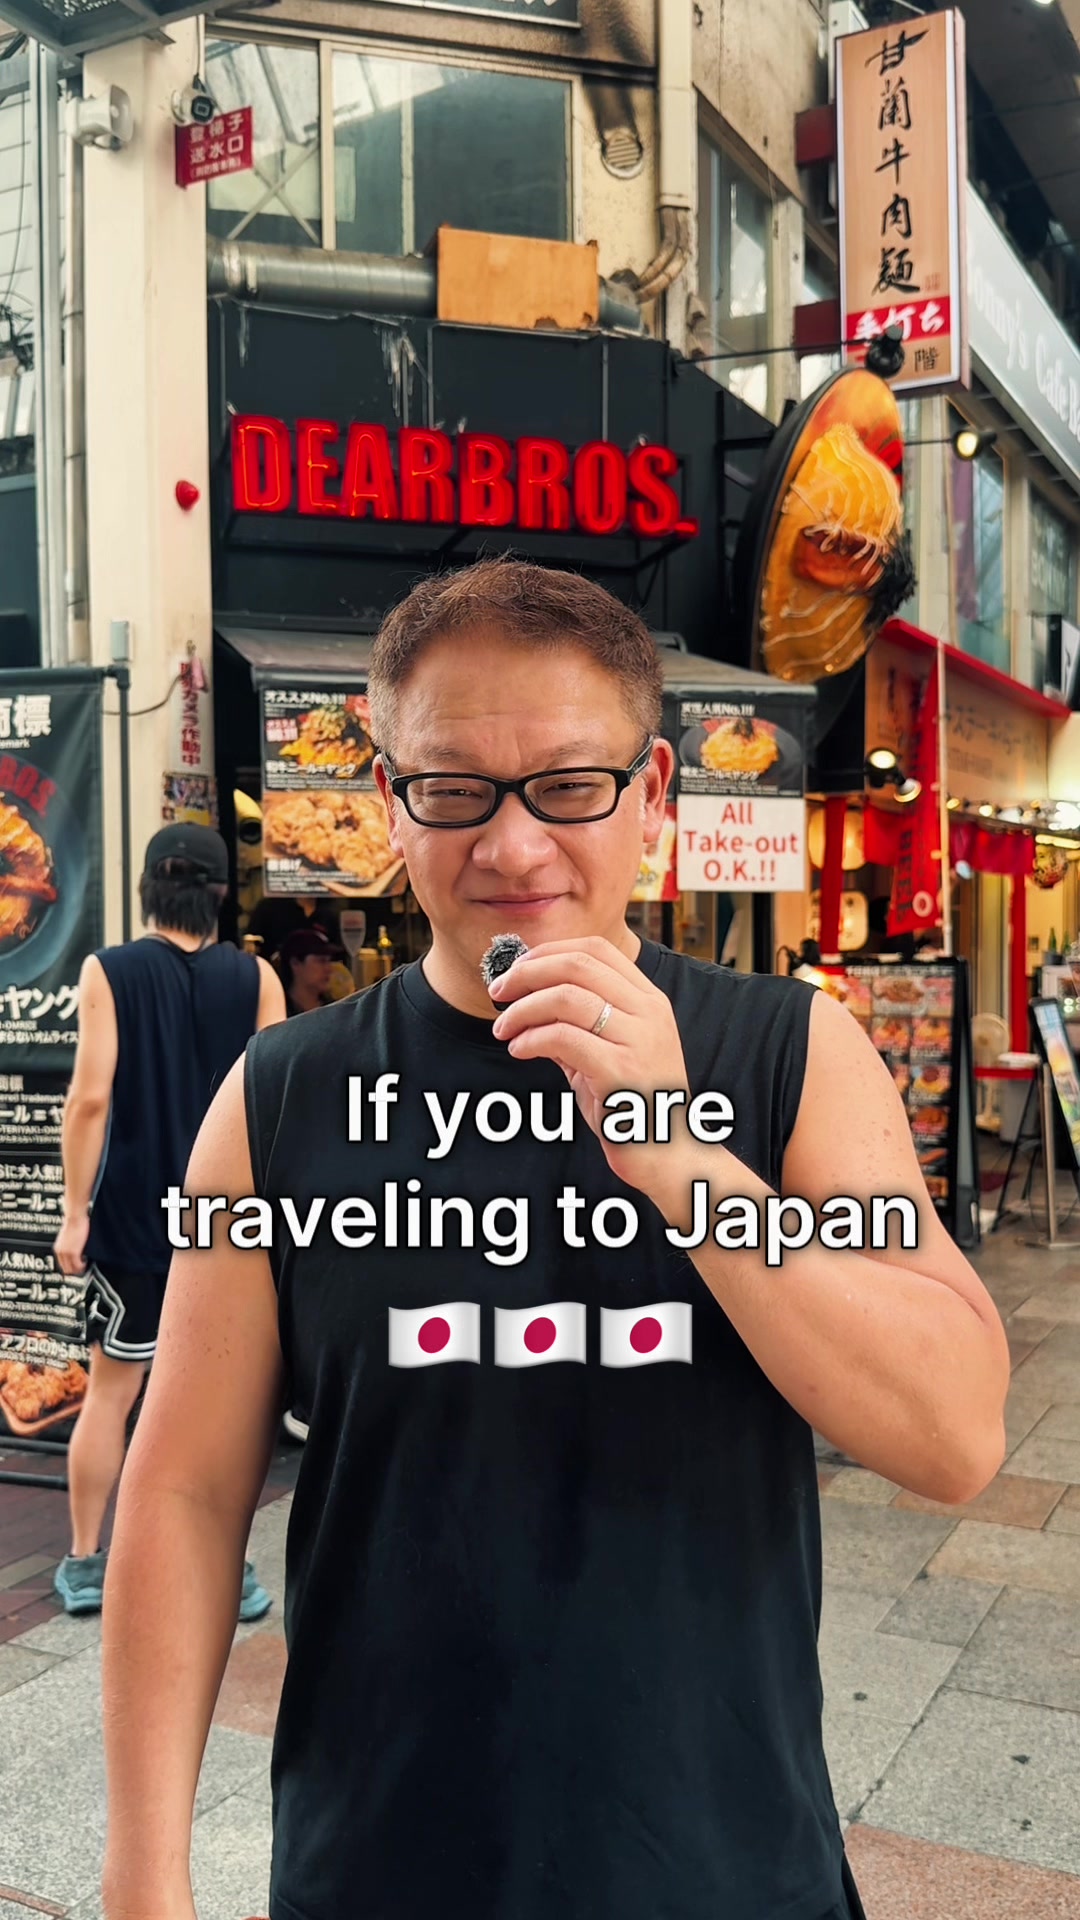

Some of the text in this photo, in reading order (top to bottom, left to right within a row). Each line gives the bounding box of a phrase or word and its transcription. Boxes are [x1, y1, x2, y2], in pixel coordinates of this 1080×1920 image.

[231, 413, 698, 538] DEARBROS.
[721, 801, 753, 825] All
[683, 829, 799, 853] Take-out
[703, 859, 776, 882] O.K.!!
